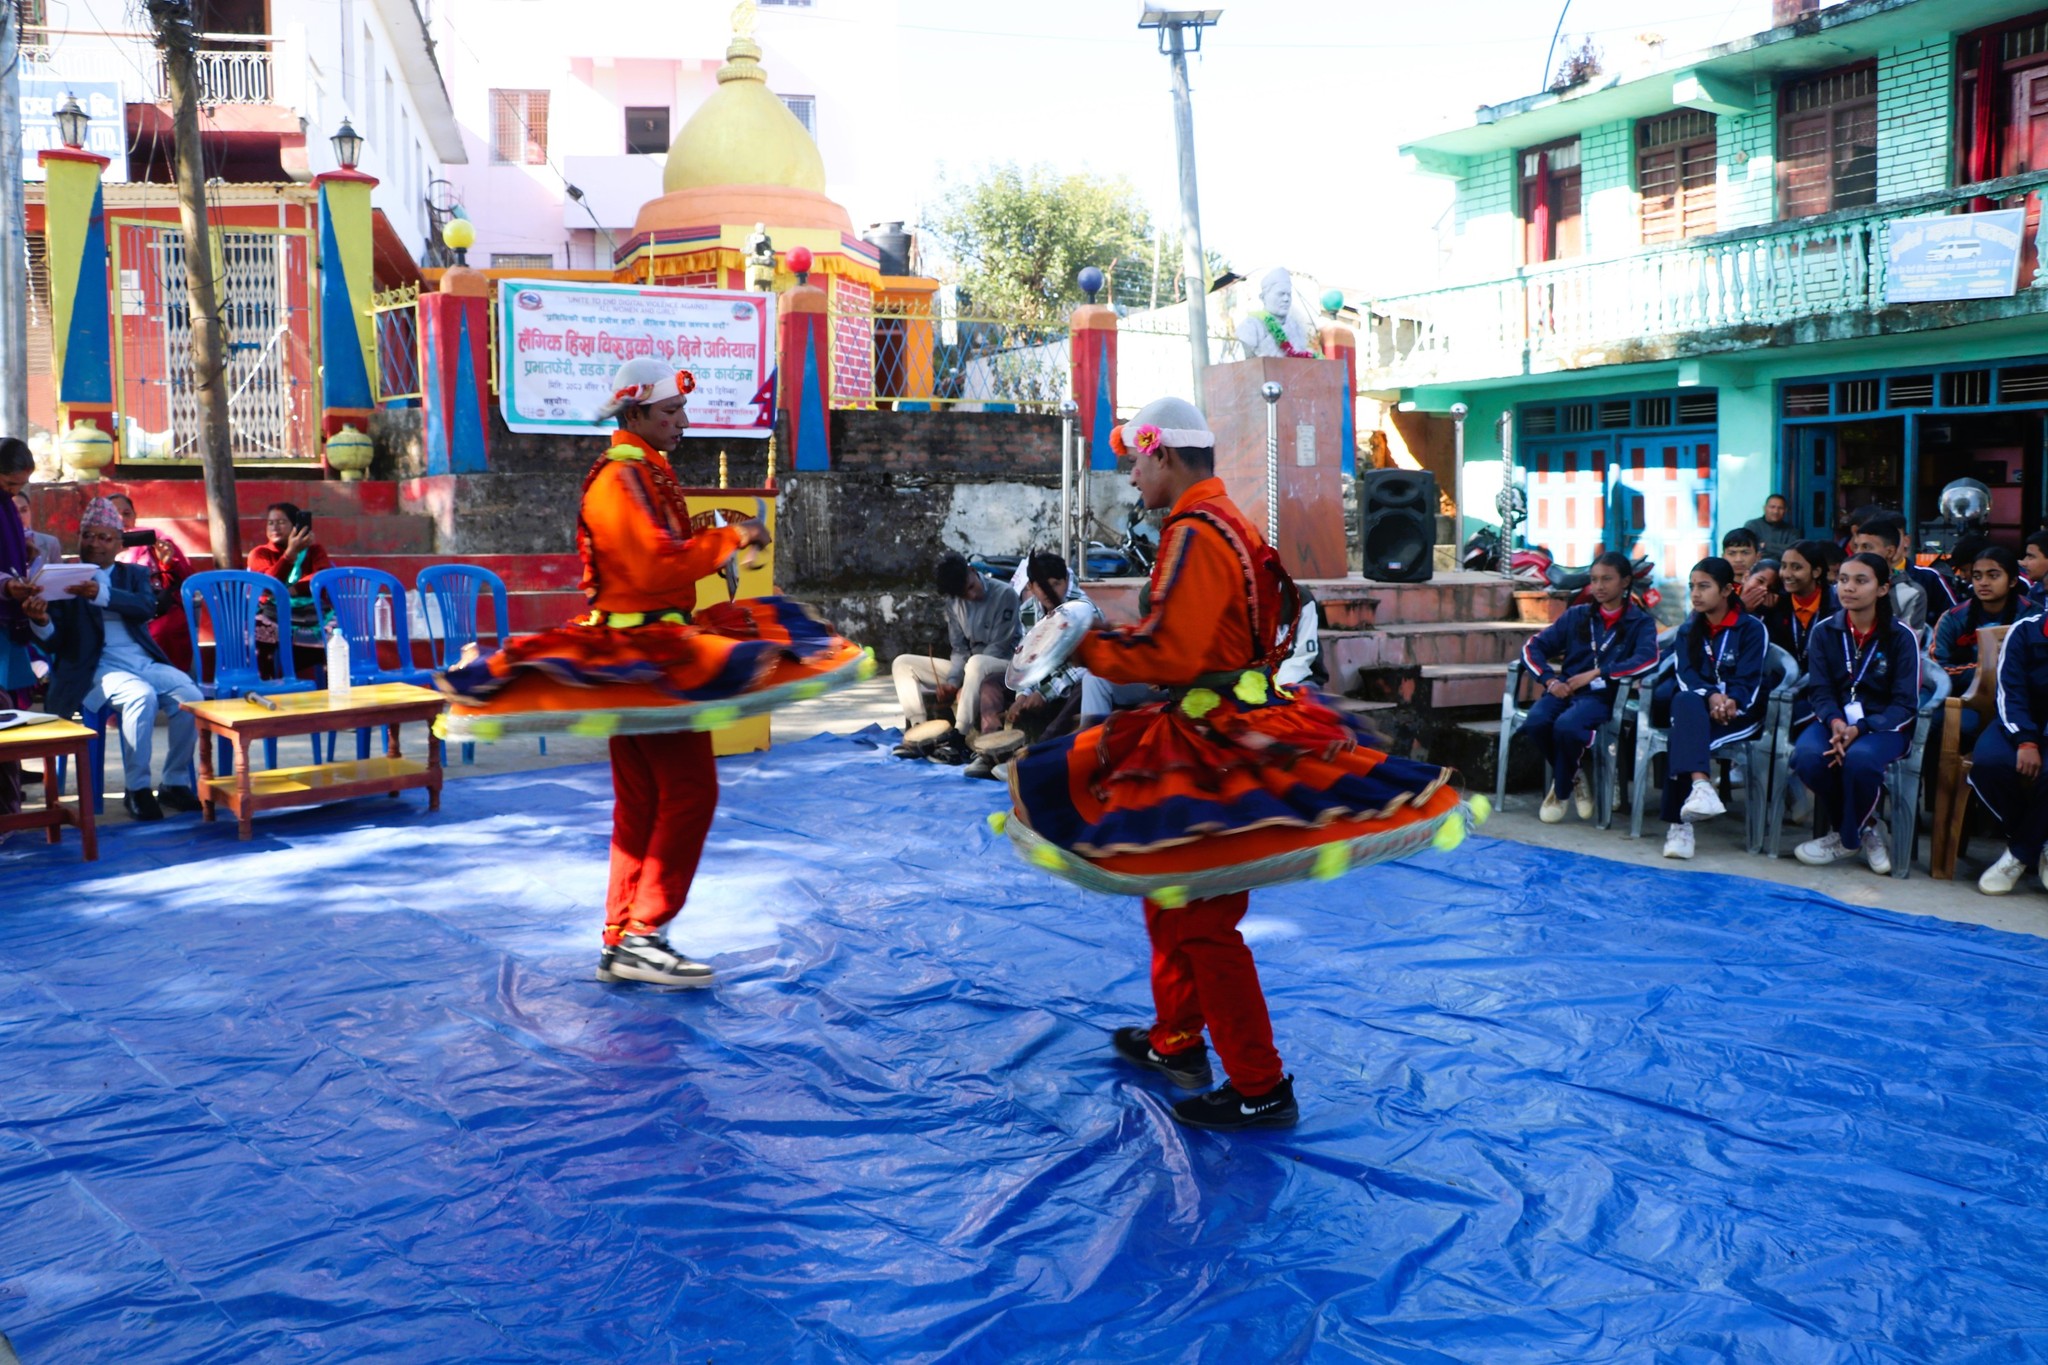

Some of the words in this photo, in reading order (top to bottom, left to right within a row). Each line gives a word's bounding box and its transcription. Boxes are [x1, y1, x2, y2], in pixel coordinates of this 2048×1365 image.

[91, 127, 119, 151] LTD.
[619, 299, 644, 307] DIGITAL
[646, 300, 678, 309] VIOLENCE
[518, 327, 563, 352] लैंगिक
[565, 329, 595, 357] हिंसा
[656, 340, 675, 360] १६
[678, 335, 701, 361] दिने
[704, 336, 756, 360] अभियान
[579, 362, 605, 376] सडक
[714, 364, 753, 382] कार्यक्रम
